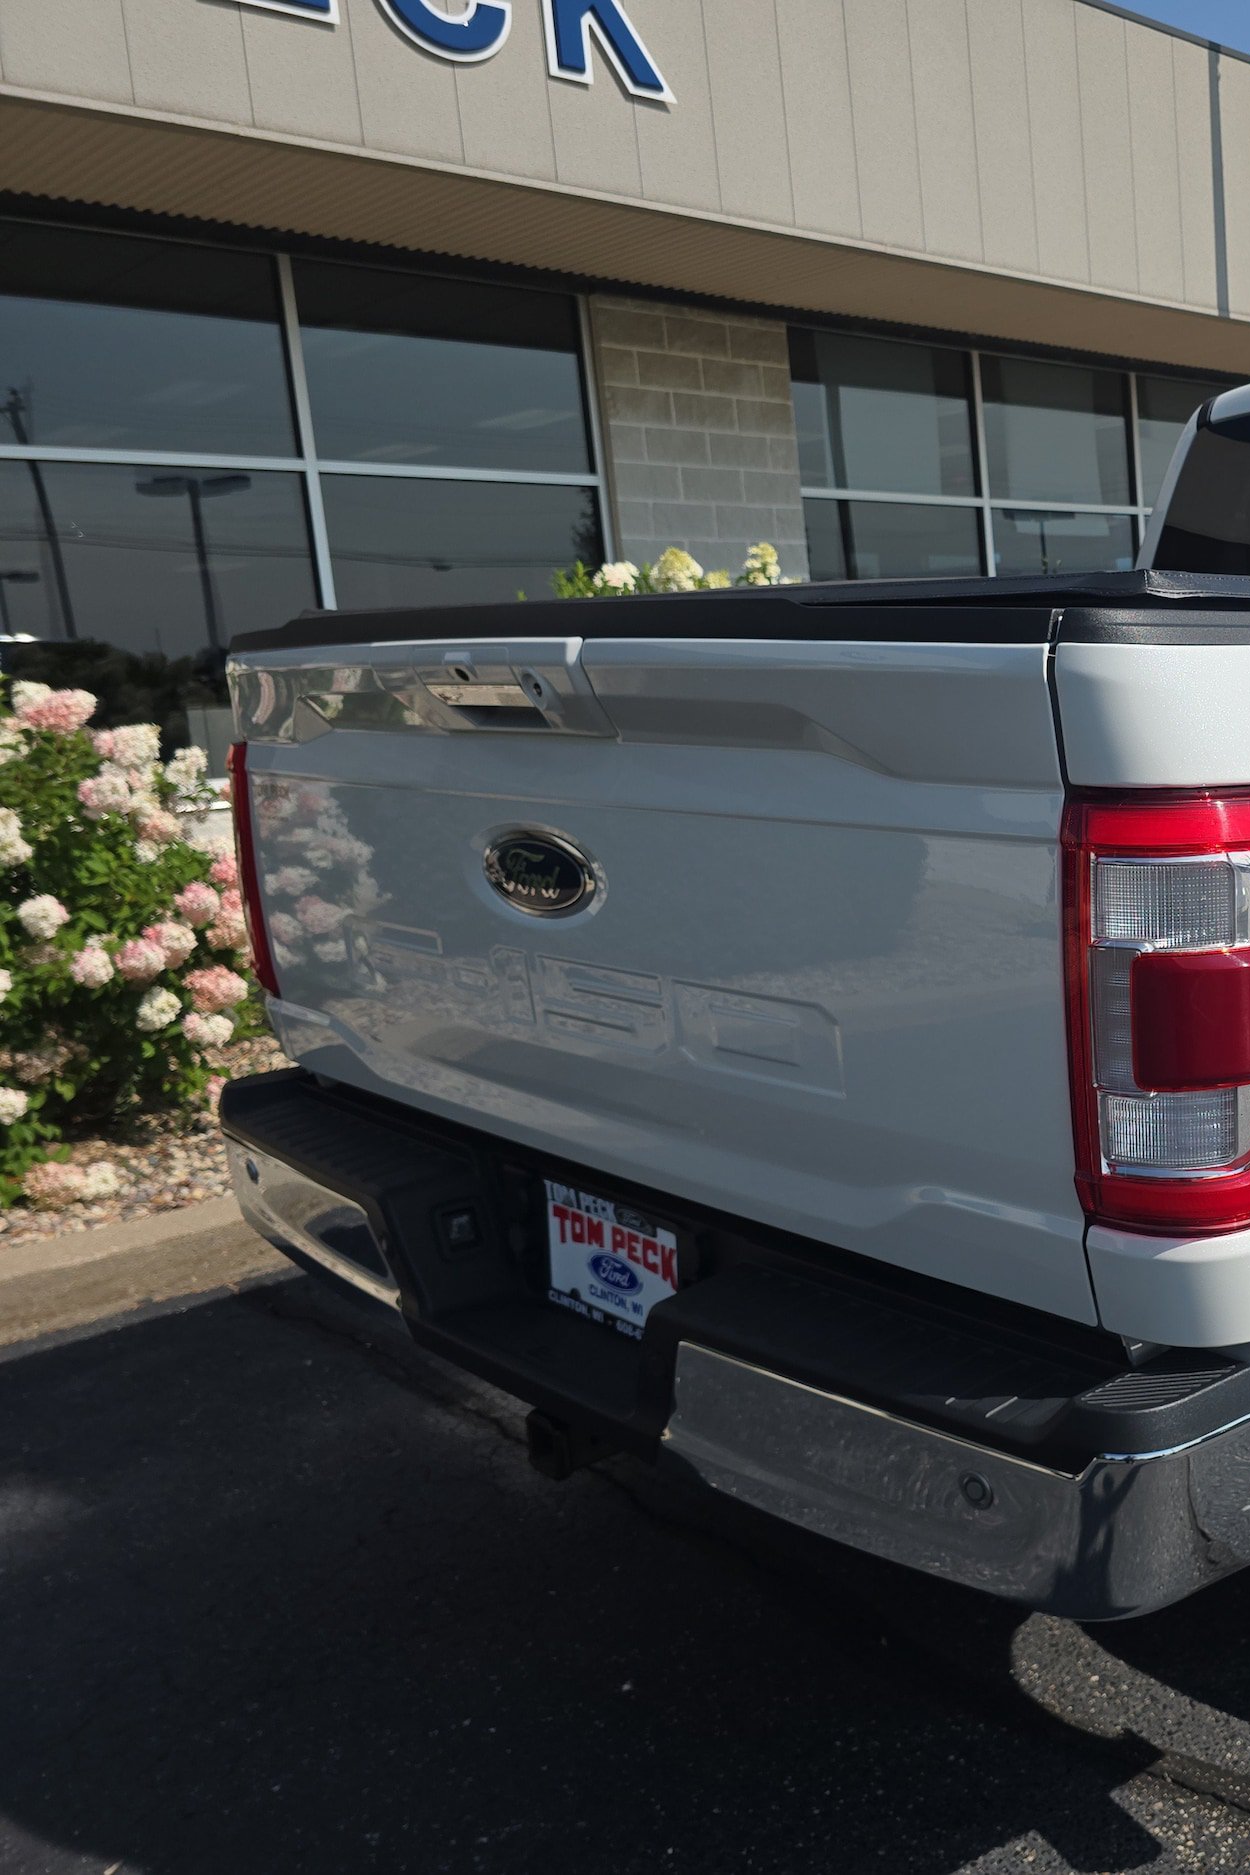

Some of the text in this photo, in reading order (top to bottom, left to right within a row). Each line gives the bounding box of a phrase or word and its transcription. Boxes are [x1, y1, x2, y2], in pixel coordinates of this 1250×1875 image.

[553, 1204, 678, 1292] TOM PECK
[600, 1256, 631, 1288] Ford
[588, 1283, 644, 1317] CLINTON, WI
